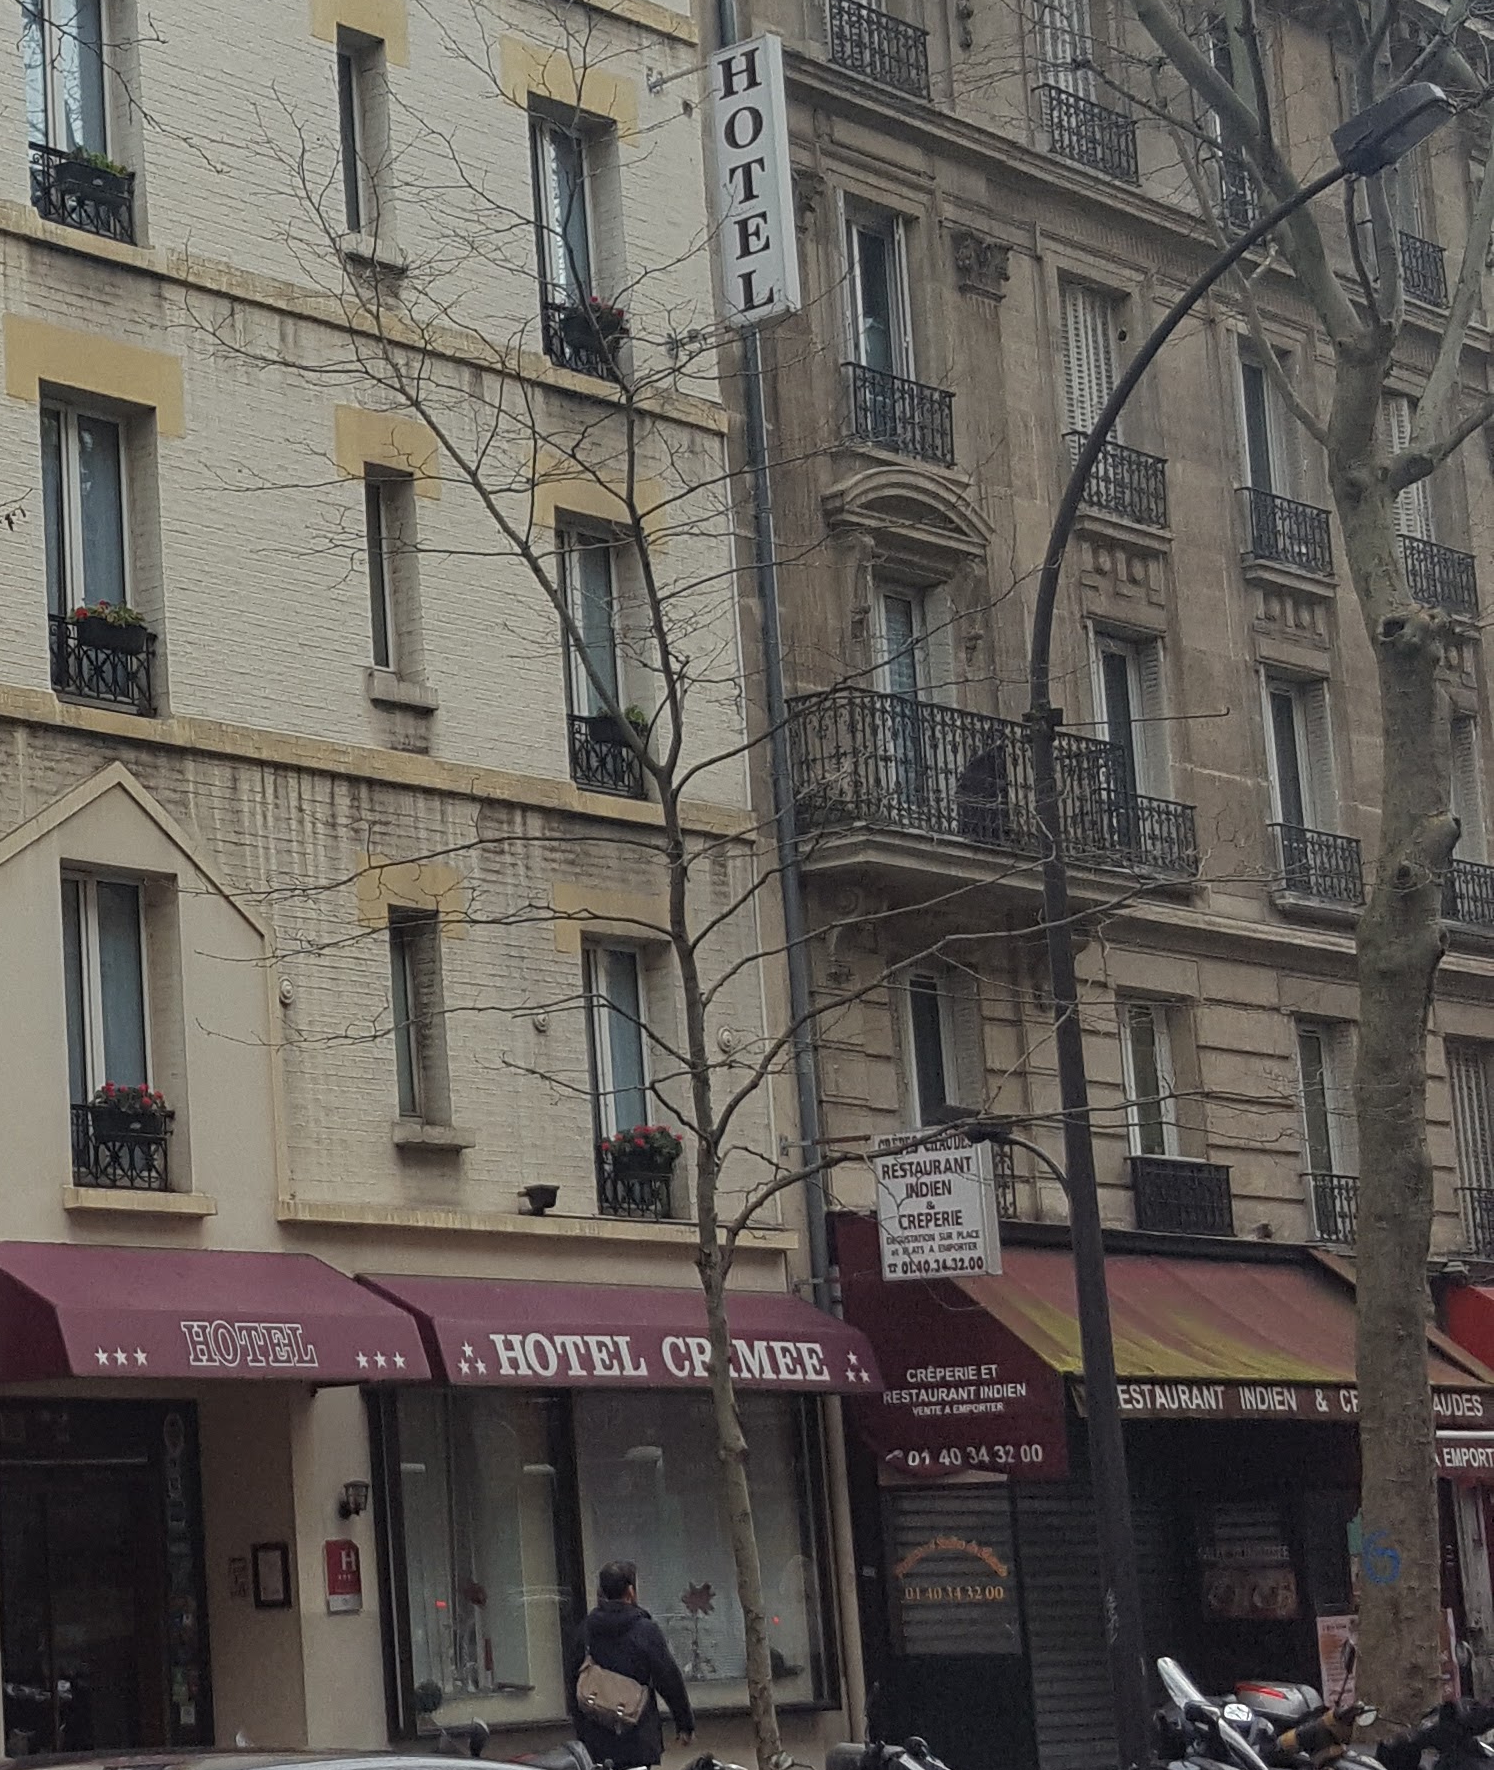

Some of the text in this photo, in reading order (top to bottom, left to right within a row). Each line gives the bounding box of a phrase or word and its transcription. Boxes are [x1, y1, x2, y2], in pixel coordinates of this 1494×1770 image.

[717, 47, 774, 312] HOTEL
[882, 1157, 972, 1180] RESTAURANT
[906, 1180, 952, 1198] INDIEN
[926, 1201, 936, 1210] &
[957, 1230, 981, 1240] PLACE
[180, 1320, 318, 1367] HOTEL
[490, 1333, 831, 1381] HOTEL CRMEE
[907, 1364, 998, 1382] CRÊPERIE ET
[883, 1383, 1026, 1405] RESTAURANT INDIEN
[1118, 1384, 1225, 1410] ESTAURANT
[1239, 1386, 1297, 1411] INDIEN
[1315, 1388, 1329, 1412] &
[913, 1405, 942, 1417] VENTE
[953, 1402, 1004, 1414] EMPORTER
[908, 1444, 1043, 1466] 01 40 34 32 00
[340, 1550, 357, 1571] H
[1362, 1531, 1401, 1584] 6
[986, 1585, 1004, 1600] 00
